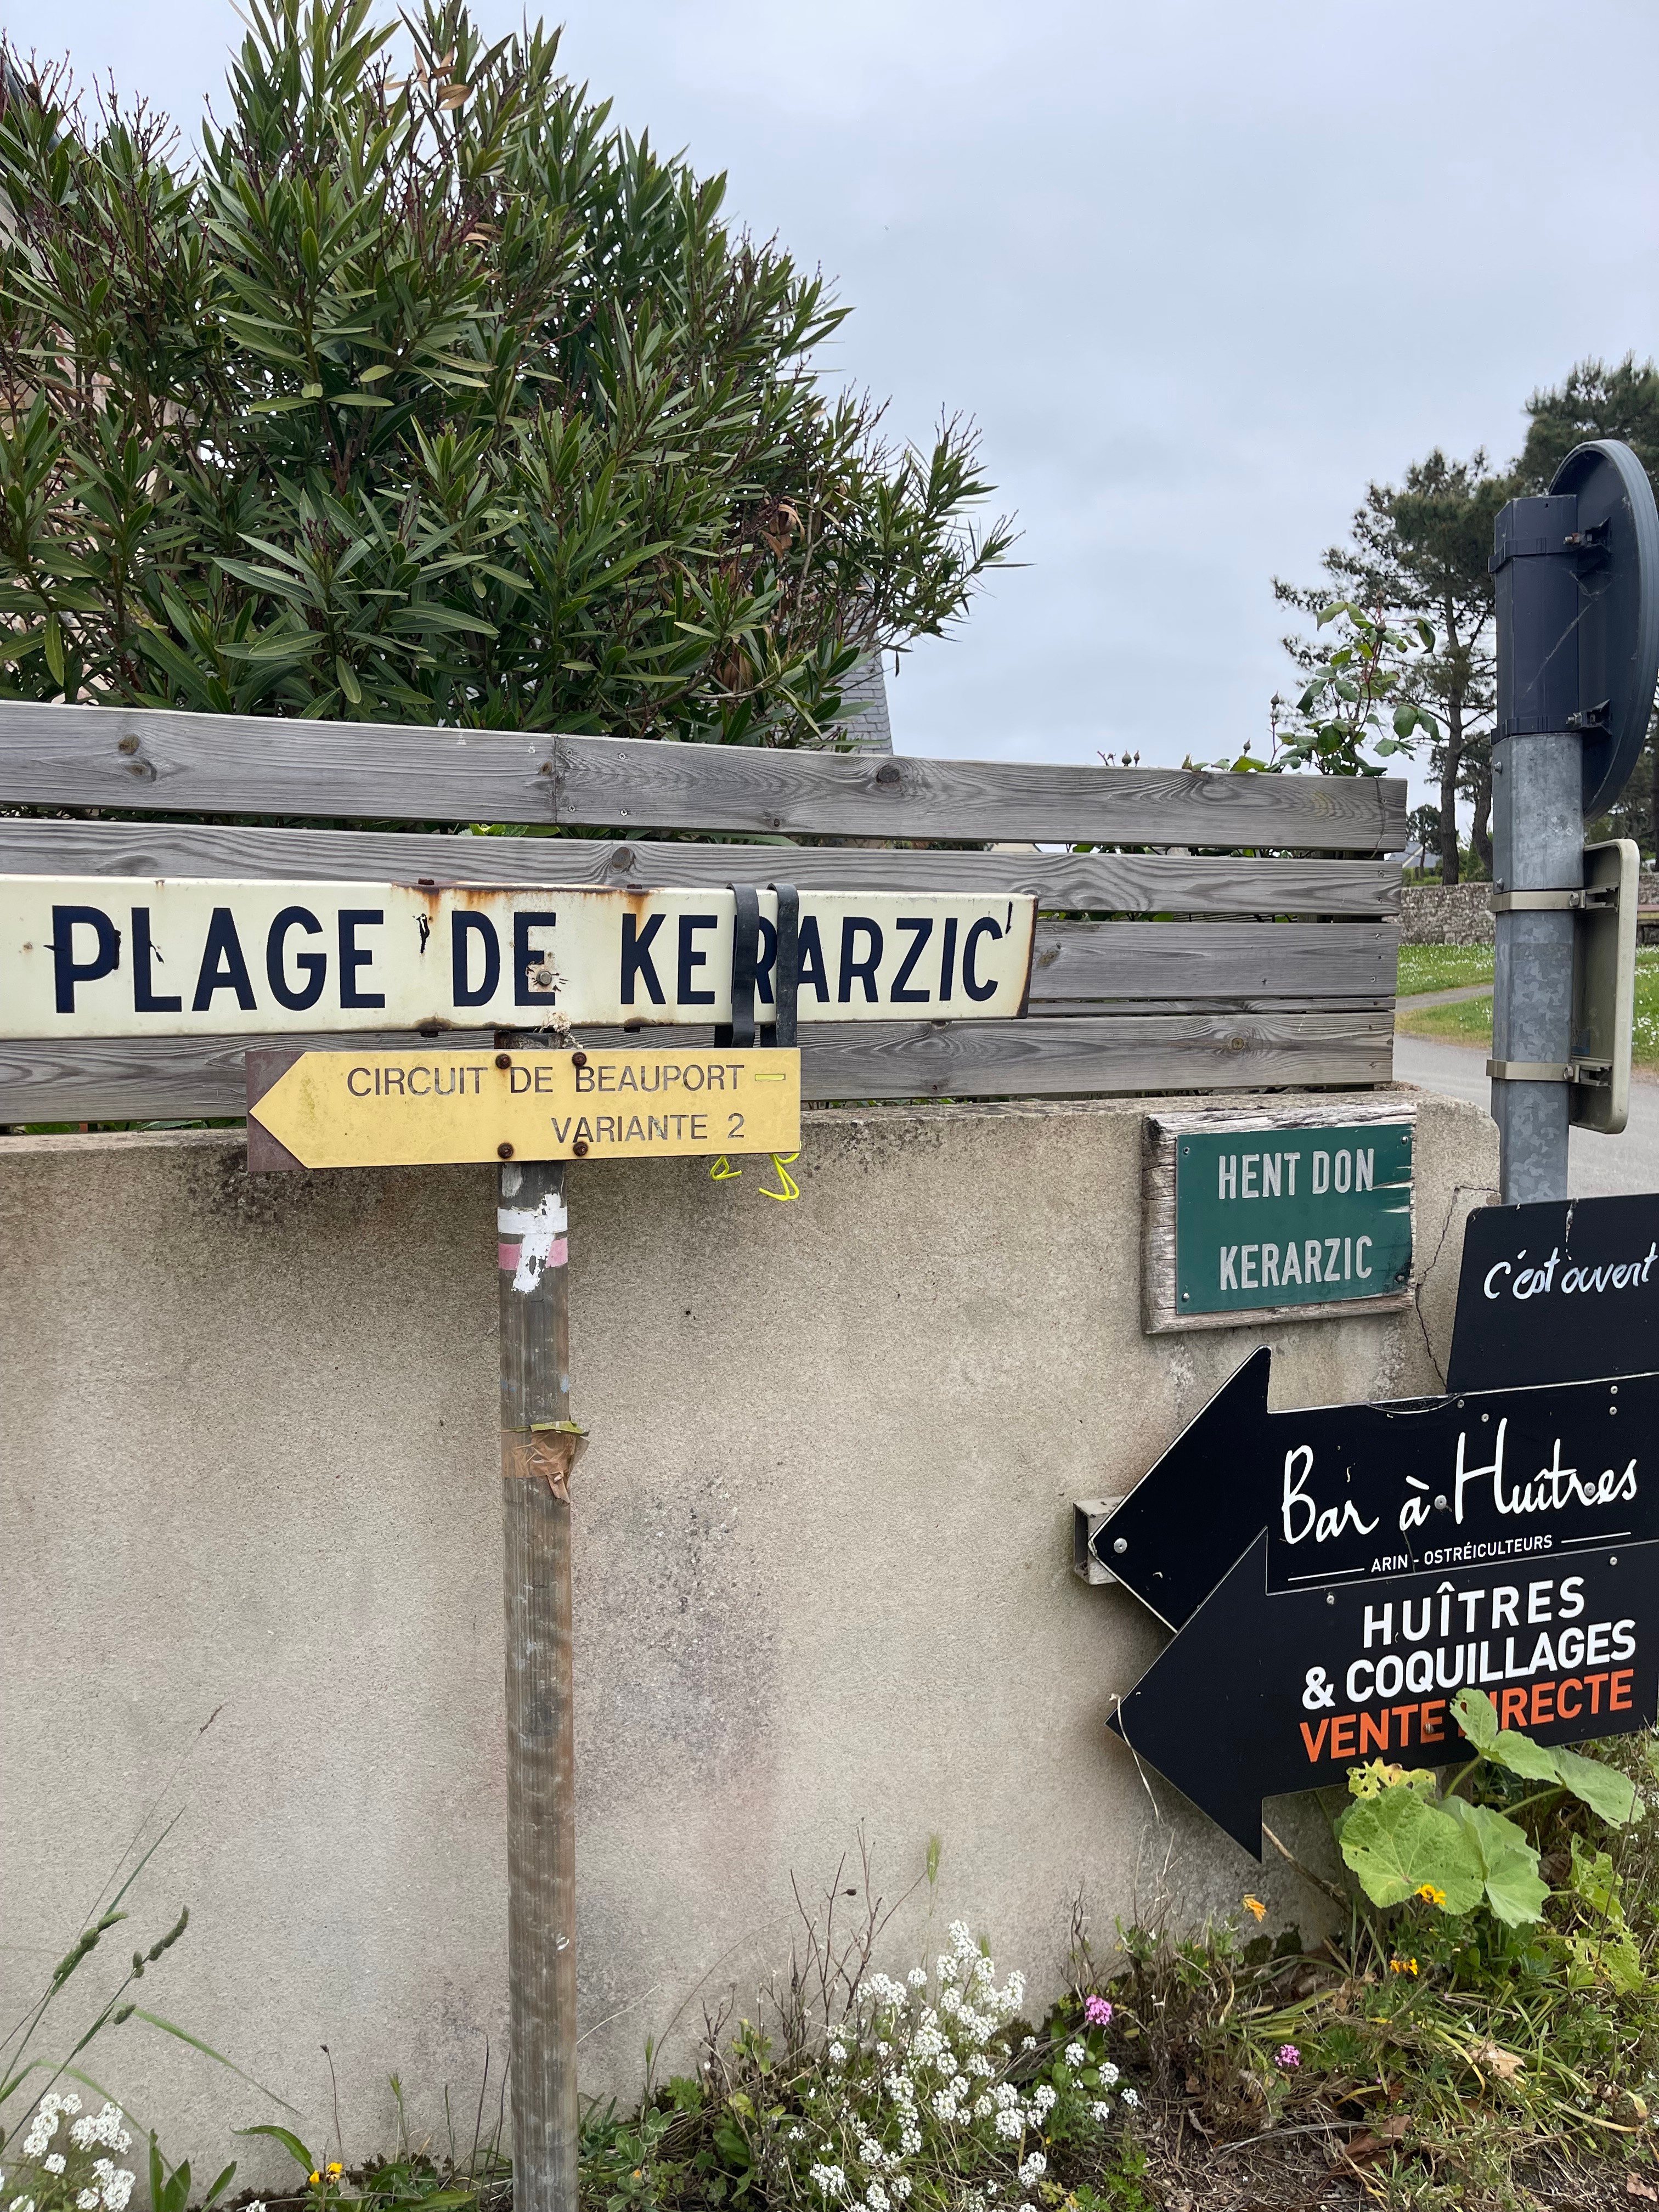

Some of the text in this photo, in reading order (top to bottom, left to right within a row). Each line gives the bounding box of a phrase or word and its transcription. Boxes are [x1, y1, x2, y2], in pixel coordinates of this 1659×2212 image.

[51, 905, 1003, 1014] PLAGE DE KERARZIC
[347, 1064, 745, 1097] CIRCUIT DE BEAUPORT
[551, 1113, 744, 1144] VARIANTE 2
[1218, 1148, 1374, 1200] HENT DON
[1220, 1235, 1373, 1291] KERARZIC
[1561, 1242, 1658, 1294] ouvert
[1281, 1417, 1638, 1544] Bar à Huîtres
[1371, 1554, 1408, 1573] ARIN
[1424, 1534, 1553, 1566] OSTRÉICULTEURS
[1363, 1576, 1585, 1649] HUÎTRES
[1301, 1618, 1637, 1710] & COQUILLAGES
[1299, 1699, 1446, 1763] VENTE
